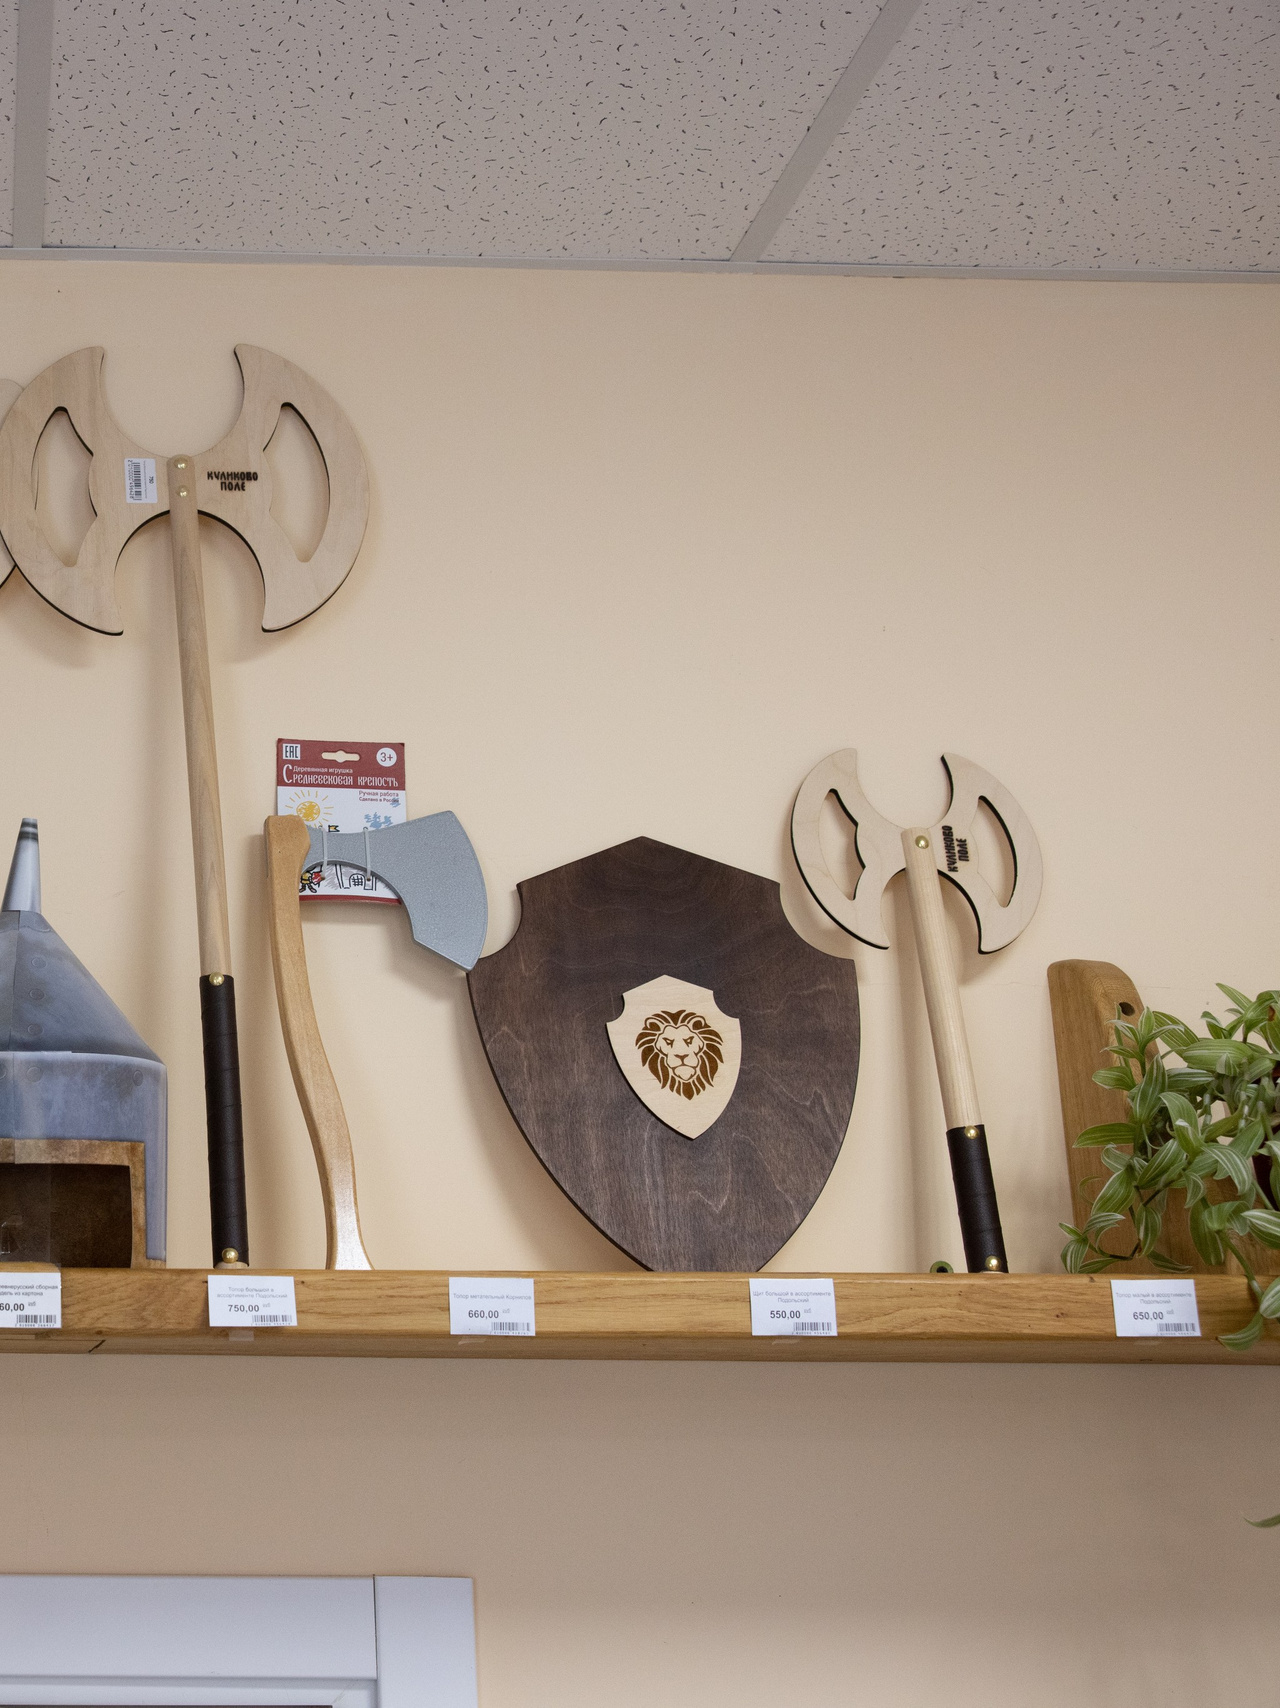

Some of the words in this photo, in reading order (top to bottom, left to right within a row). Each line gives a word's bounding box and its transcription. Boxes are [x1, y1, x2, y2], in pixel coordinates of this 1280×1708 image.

[207, 471, 258, 482] КУЛИКОВО
[220, 482, 246, 492] ПОЛЕ
[380, 752, 393, 762] 3+
[956, 838, 970, 862] ПОЛЕ
[228, 1304, 260, 1313] 750,00
[468, 1310, 499, 1320] 660,00
[770, 1311, 801, 1320] 550,00
[1133, 1312, 1164, 1321] 650,00
